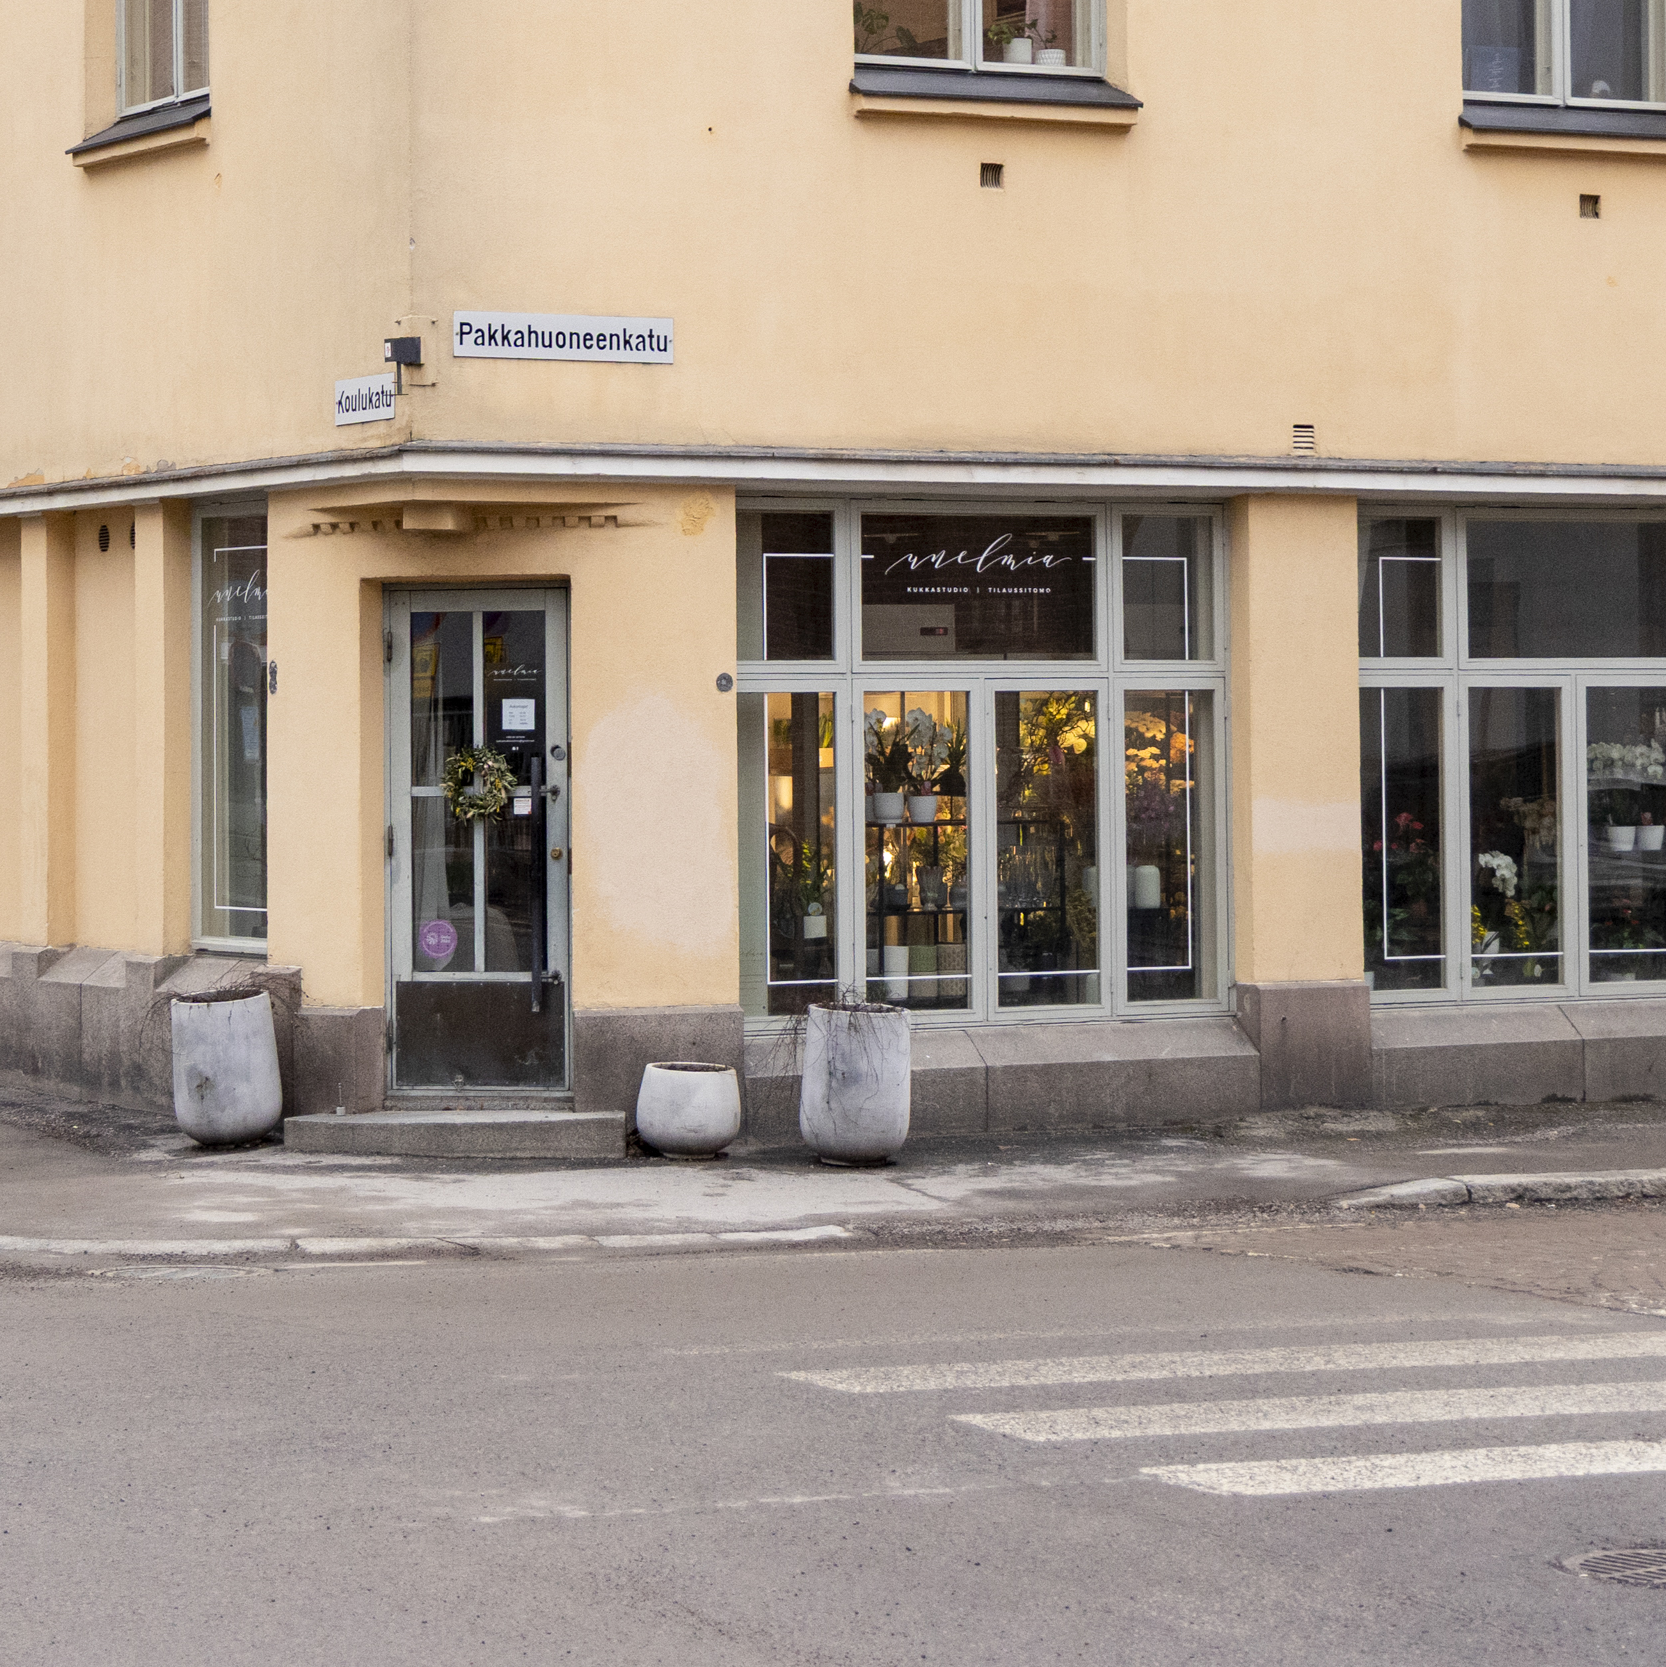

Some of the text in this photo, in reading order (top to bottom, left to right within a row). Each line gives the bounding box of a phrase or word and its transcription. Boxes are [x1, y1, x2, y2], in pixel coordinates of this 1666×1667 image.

[459, 321, 668, 353] Pakkahuoneenkatu
[337, 384, 393, 415] Koulukatu
[906, 586, 969, 594] KUKKASTUDIO
[988, 586, 1052, 594] TILAUSSITOMO
